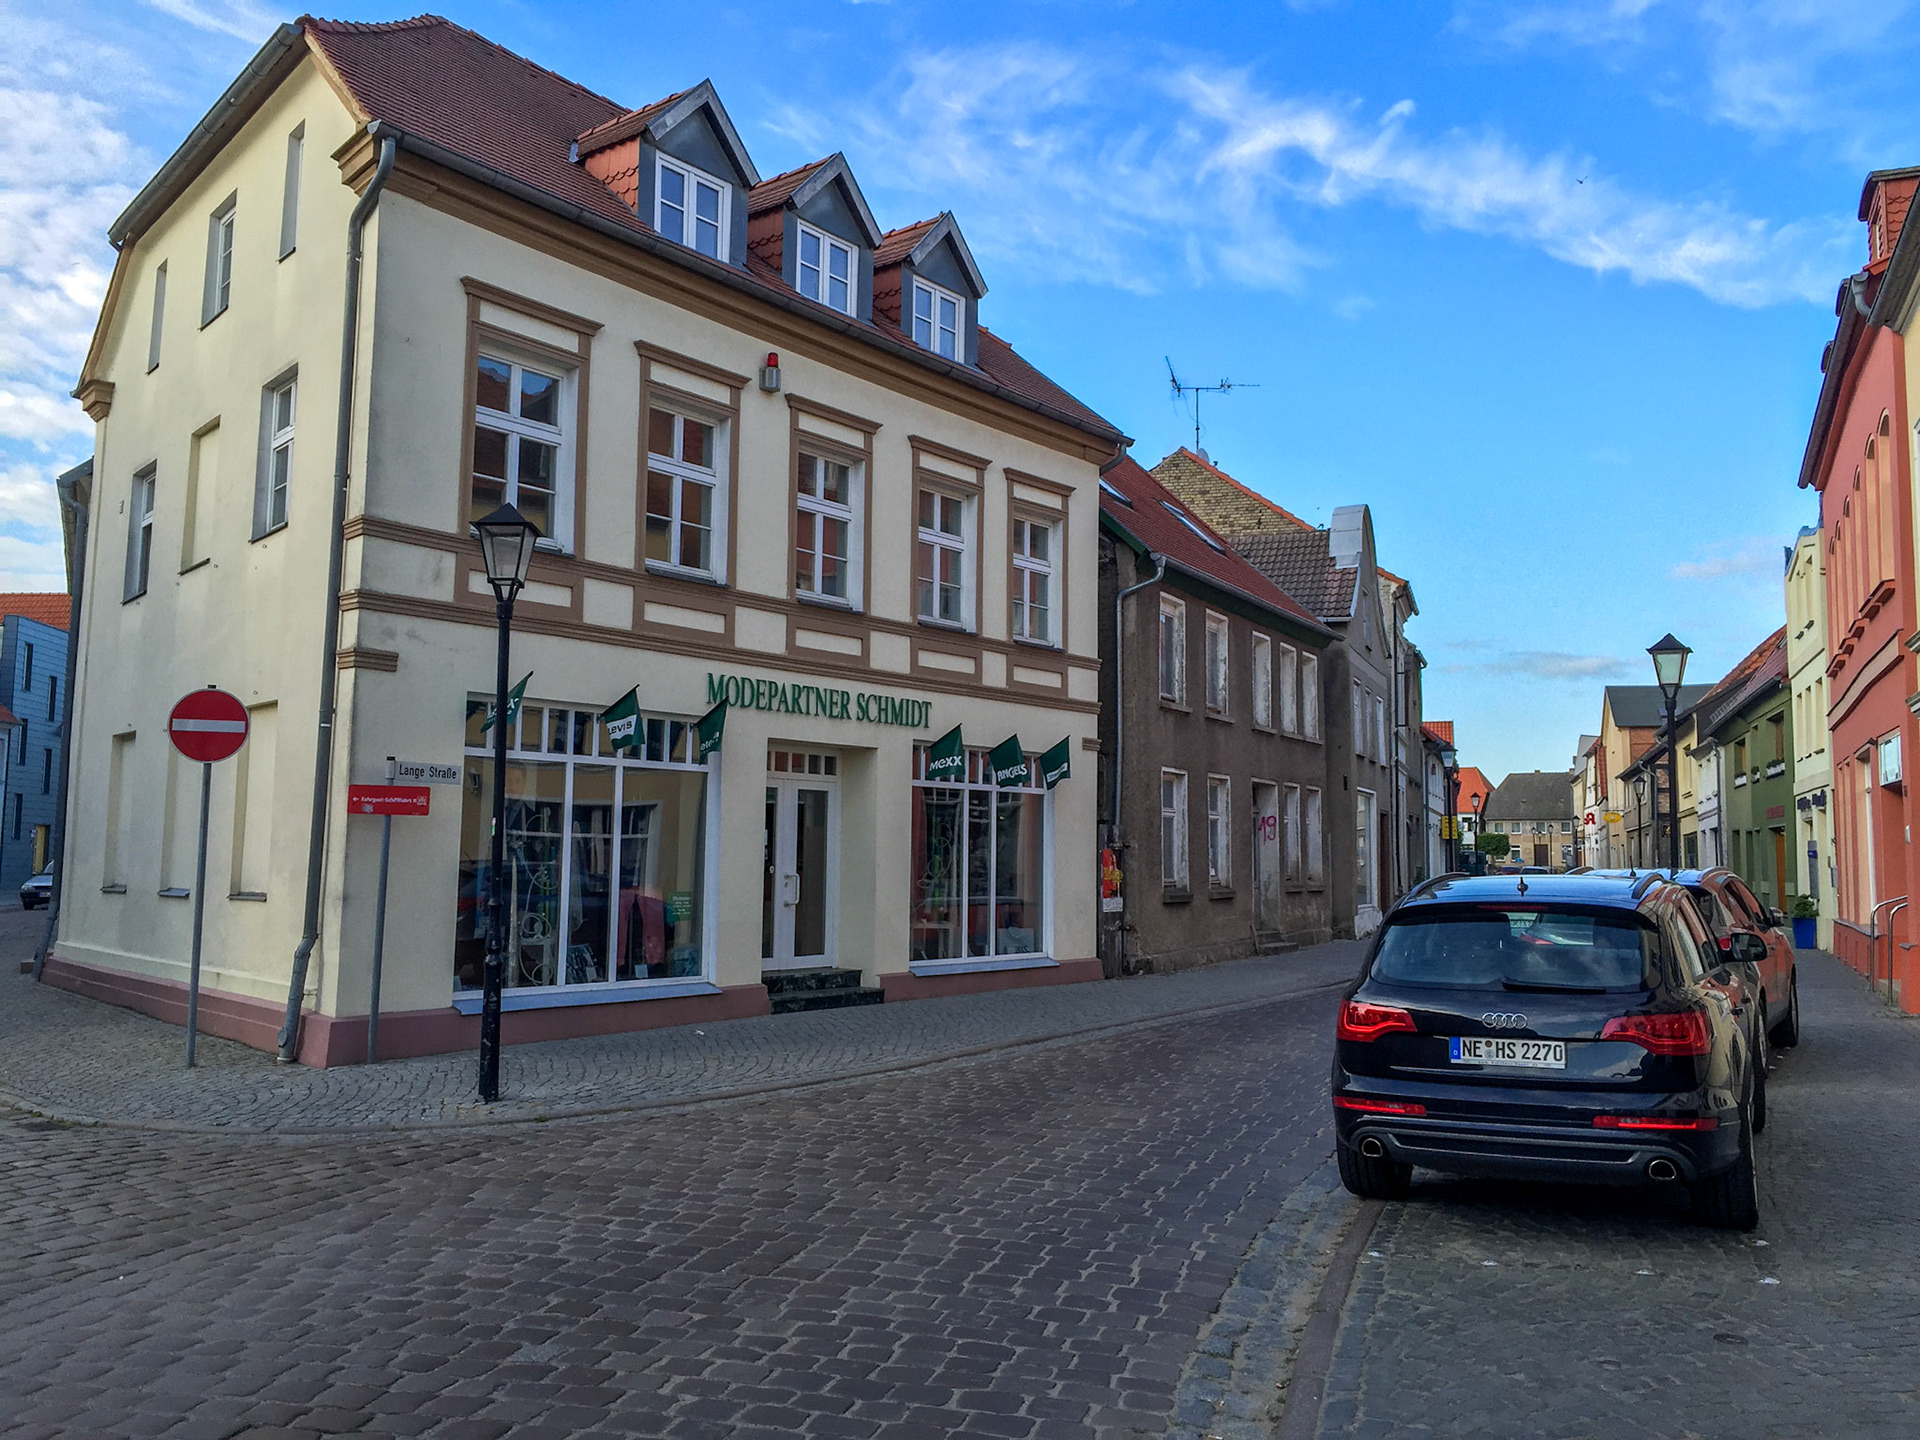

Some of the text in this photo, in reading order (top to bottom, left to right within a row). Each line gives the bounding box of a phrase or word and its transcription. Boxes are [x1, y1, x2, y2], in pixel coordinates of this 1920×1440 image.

[707, 673, 932, 729] MODEPARTNER SCHMIDT
[399, 764, 457, 780] Lange Straße
[997, 763, 1028, 782] ANGELS
[1462, 1040, 1563, 1062] NE HS 2270
